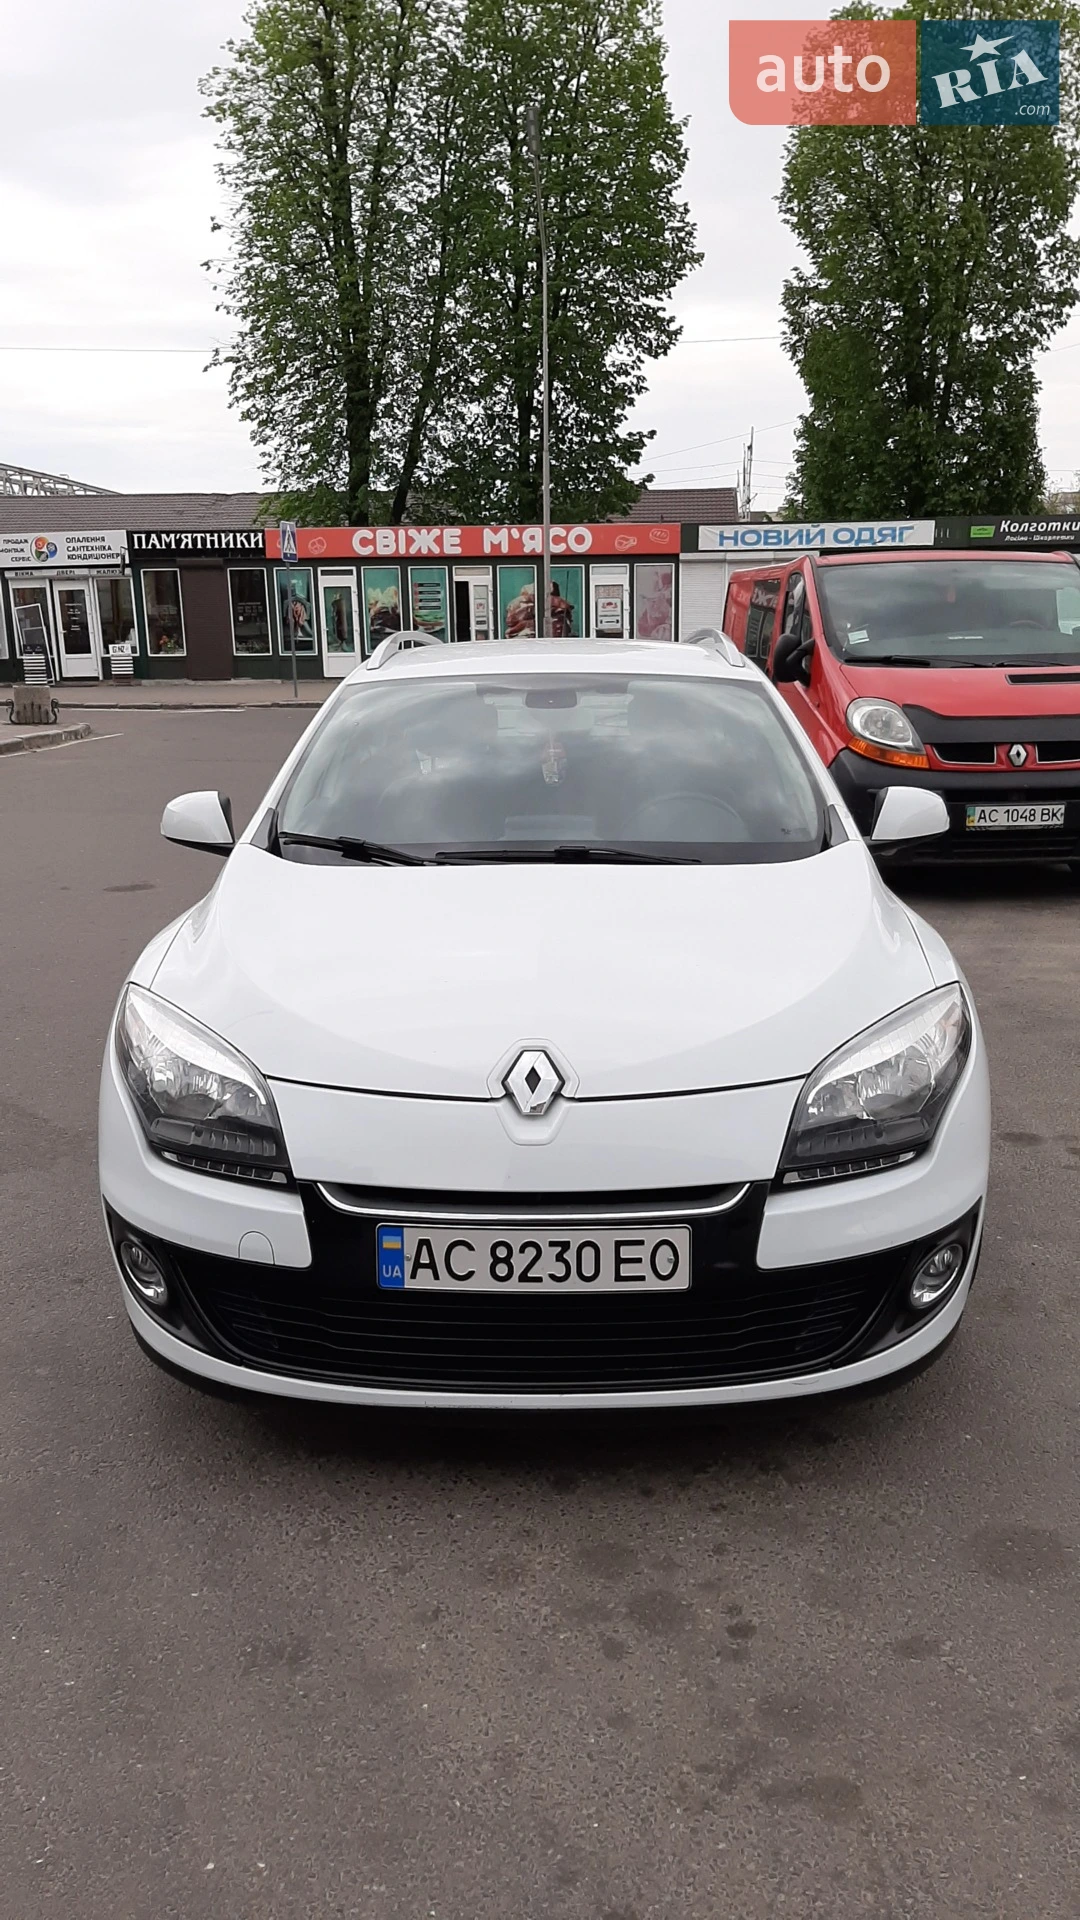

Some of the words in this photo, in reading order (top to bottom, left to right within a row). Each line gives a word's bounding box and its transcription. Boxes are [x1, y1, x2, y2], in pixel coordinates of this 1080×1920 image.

[1000, 520, 1080, 532] Колготки
[65, 536, 106, 544] ОПАЛЕННЯ
[132, 532, 264, 549] ПАМ'ЯТНИКИ
[352, 528, 462, 555] СВІЖЕ
[718, 524, 826, 547] НОВИЙ
[828, 525, 914, 546] ОДЯГ
[977, 809, 998, 823] AC
[1003, 808, 1036, 822] 1048
[1040, 808, 1062, 822] BK
[409, 1238, 476, 1282] AC
[489, 1239, 601, 1283] 8230
[613, 1238, 680, 1282] EO
[382, 1265, 402, 1279] UA
